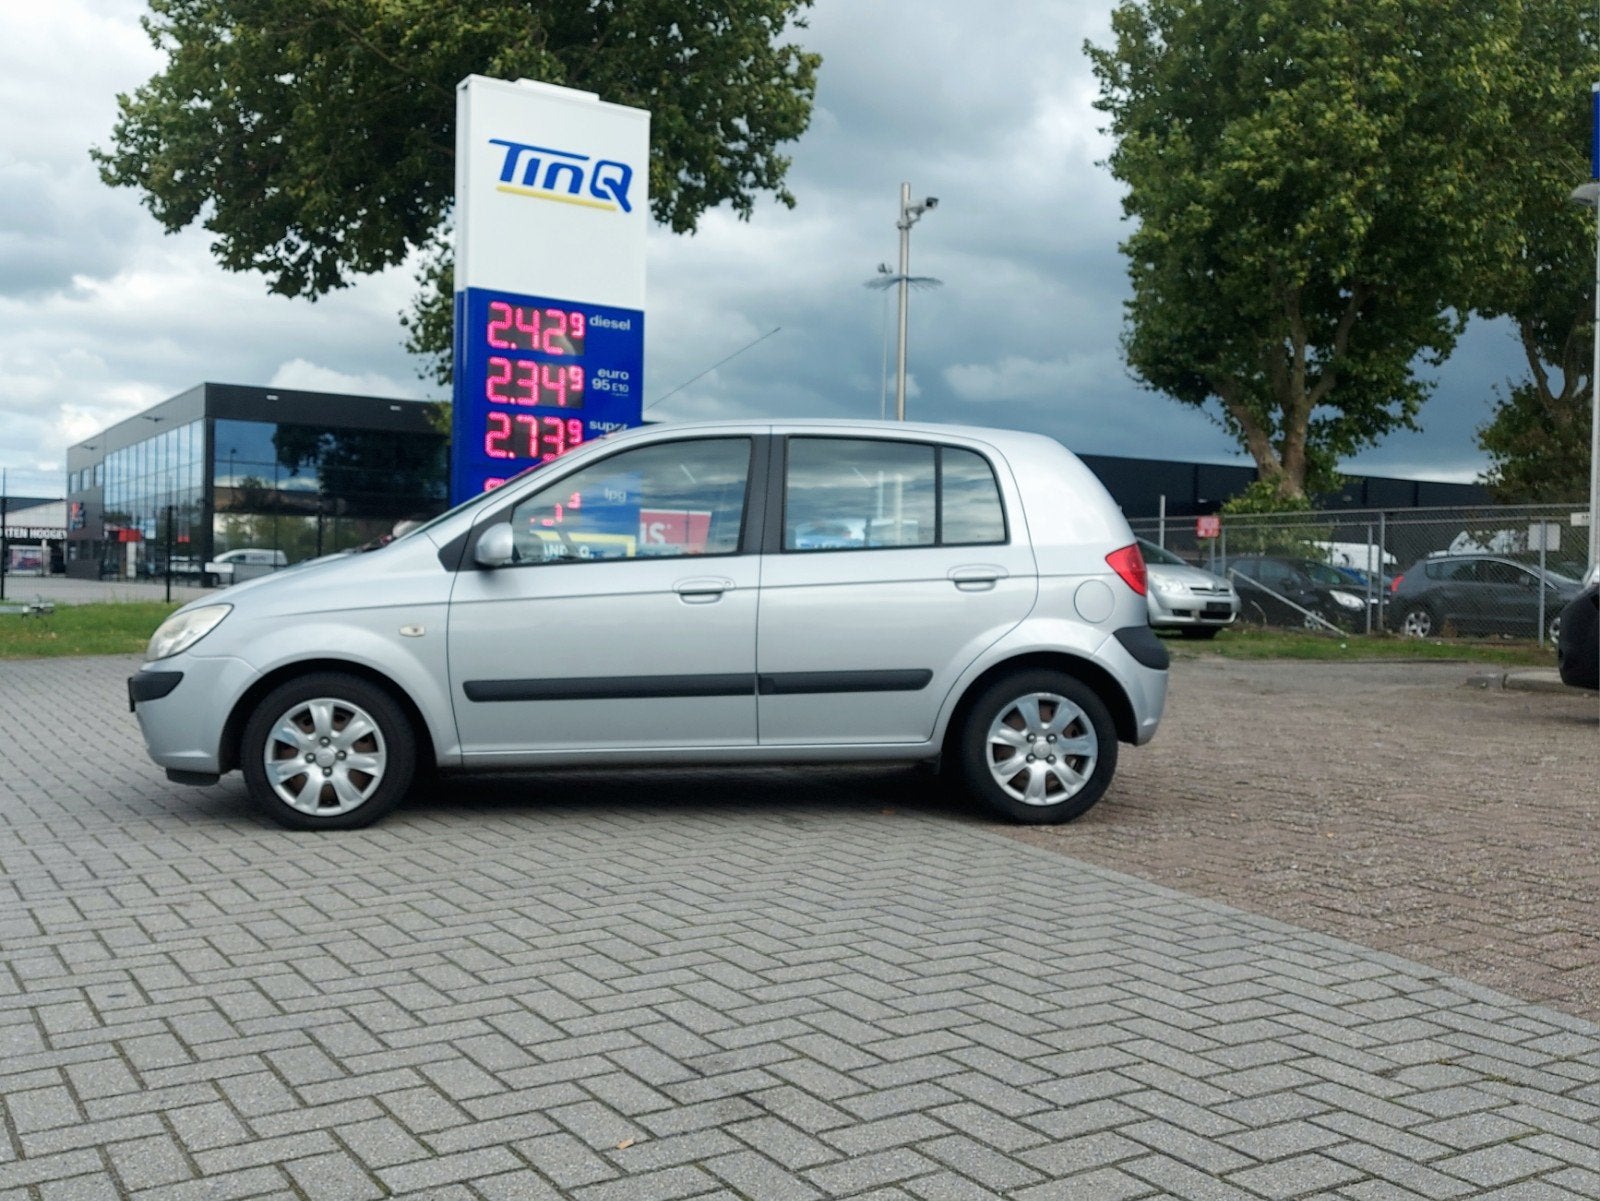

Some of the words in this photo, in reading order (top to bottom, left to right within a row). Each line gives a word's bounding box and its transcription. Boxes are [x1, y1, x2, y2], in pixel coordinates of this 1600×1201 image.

[589, 315, 631, 331] diesel
[597, 368, 630, 380] euro
[592, 377, 611, 391] 95
[612, 383, 629, 392] E10
[604, 488, 627, 502] lpg
